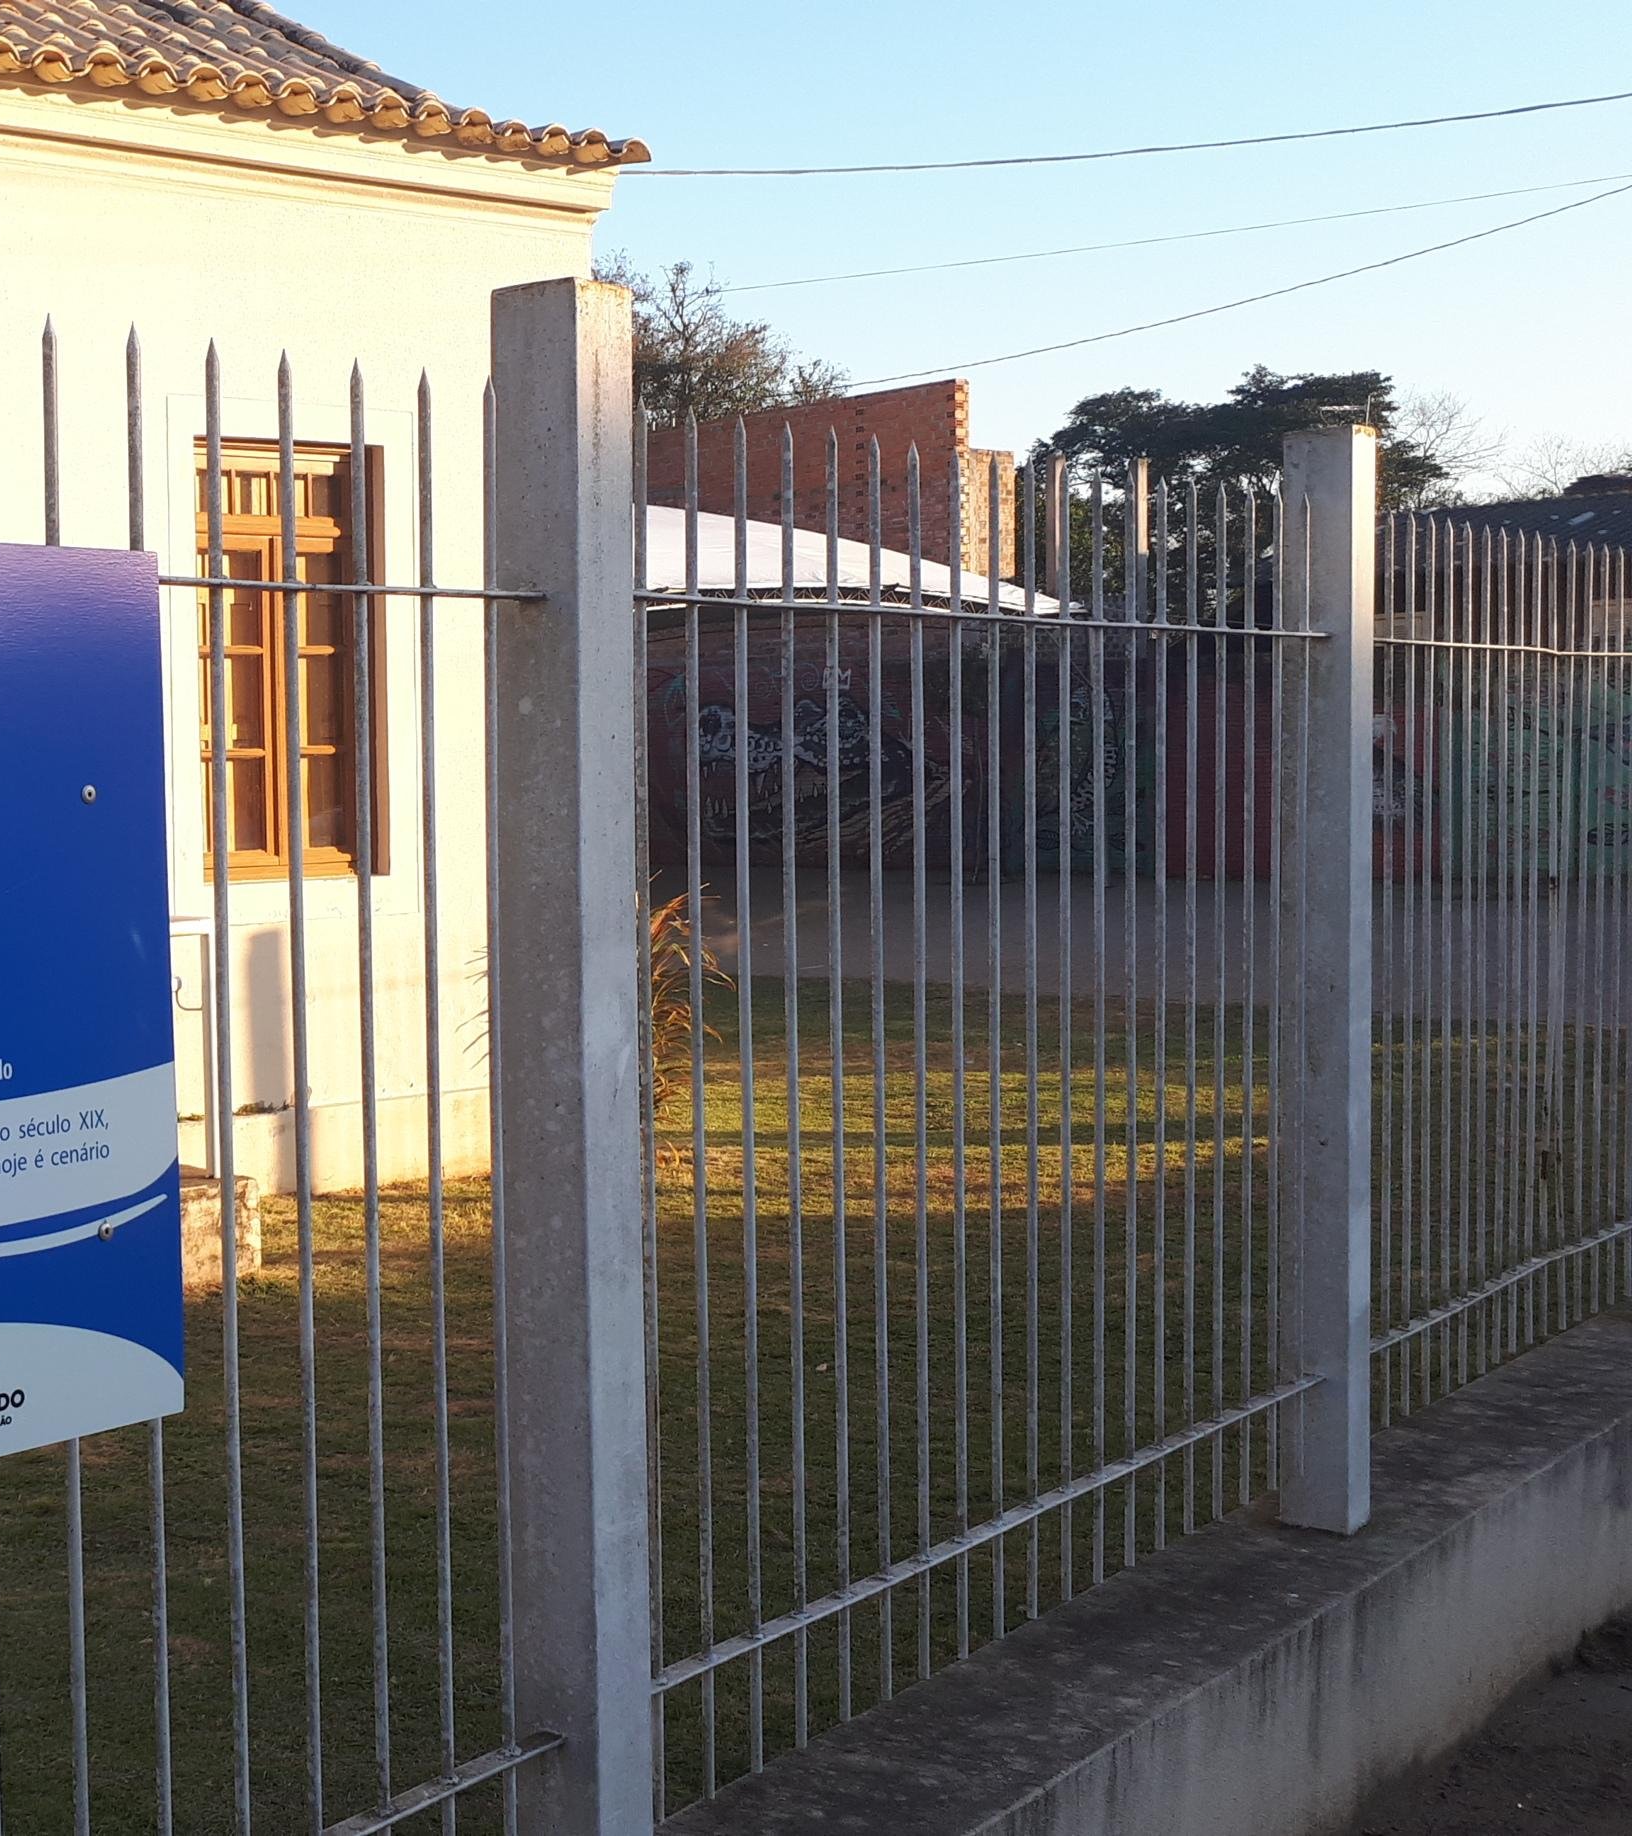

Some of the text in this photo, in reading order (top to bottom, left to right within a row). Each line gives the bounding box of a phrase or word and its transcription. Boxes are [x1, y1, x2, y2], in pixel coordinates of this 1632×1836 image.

[19, 1114, 70, 1139] século
[79, 1109, 109, 1131] XIX,
[34, 1150, 45, 1168] é
[51, 1141, 110, 1166] cenário
